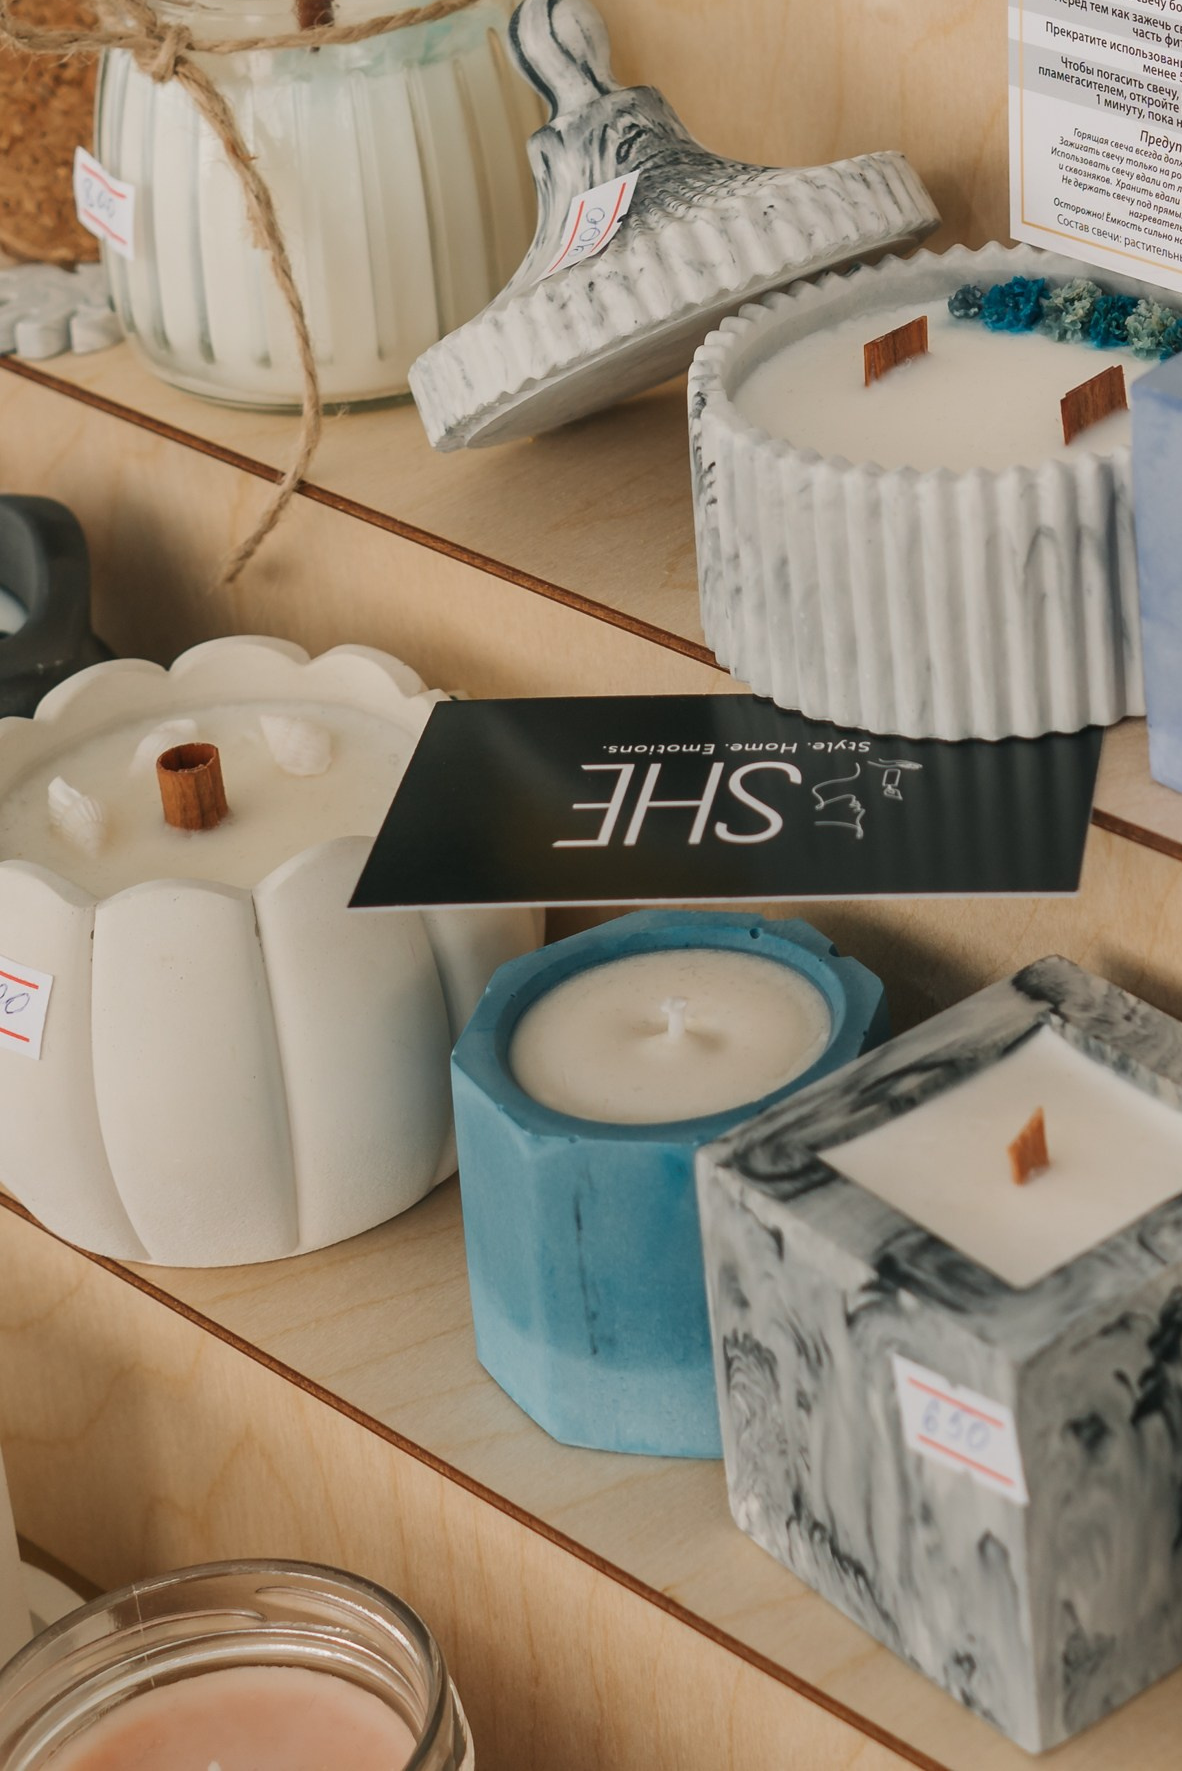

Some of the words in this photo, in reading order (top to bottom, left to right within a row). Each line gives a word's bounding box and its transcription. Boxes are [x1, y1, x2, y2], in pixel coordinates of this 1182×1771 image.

[1045, 20, 1108, 49] Прекратите
[1088, 1, 1109, 16] тем
[1111, 7, 1131, 21] как
[1131, 12, 1172, 36] зажечь
[1132, 26, 1163, 43] часть
[1038, 65, 1129, 104] пламегасителем,
[1127, 91, 1180, 114] откройте
[1060, 55, 1095, 77] Чтобы
[1096, 68, 1145, 90] погасить
[1146, 82, 1180, 102] свечу,
[1142, 63, 1177, 82] менее
[1103, 98, 1146, 120] минуту,
[1147, 110, 1174, 126] пока
[1058, 135, 1101, 157] Зажигать
[1101, 148, 1127, 166] свечу
[1125, 157, 1159, 173] только
[1158, 166, 1171, 178] на
[1073, 127, 1110, 147] Горящая
[1109, 140, 1134, 154] свеча
[1133, 147, 1165, 164] всегда
[1050, 145, 1111, 172] Использовать
[1111, 164, 1137, 183] свечу
[1134, 171, 1164, 189] вдали
[1161, 180, 1178, 192] от
[1064, 164, 1115, 187] сквозняков.
[1114, 176, 1155, 201] Хранить
[1154, 190, 1181, 209] вдали
[1061, 173, 1073, 186] Не
[1072, 177, 1112, 198] держать
[1111, 190, 1136, 207] свечу
[1134, 197, 1153, 211] под
[1053, 196, 1105, 221] Осторожно!
[1105, 211, 1144, 233] Ёмкость
[1142, 224, 1174, 242] сильно
[1056, 213, 1090, 234] Состав
[1091, 226, 1123, 244] свечи:
[602, 742, 716, 756] Emotions.
[724, 741, 798, 755] Home.
[806, 739, 872, 754] Style.
[551, 760, 802, 848] SHE
